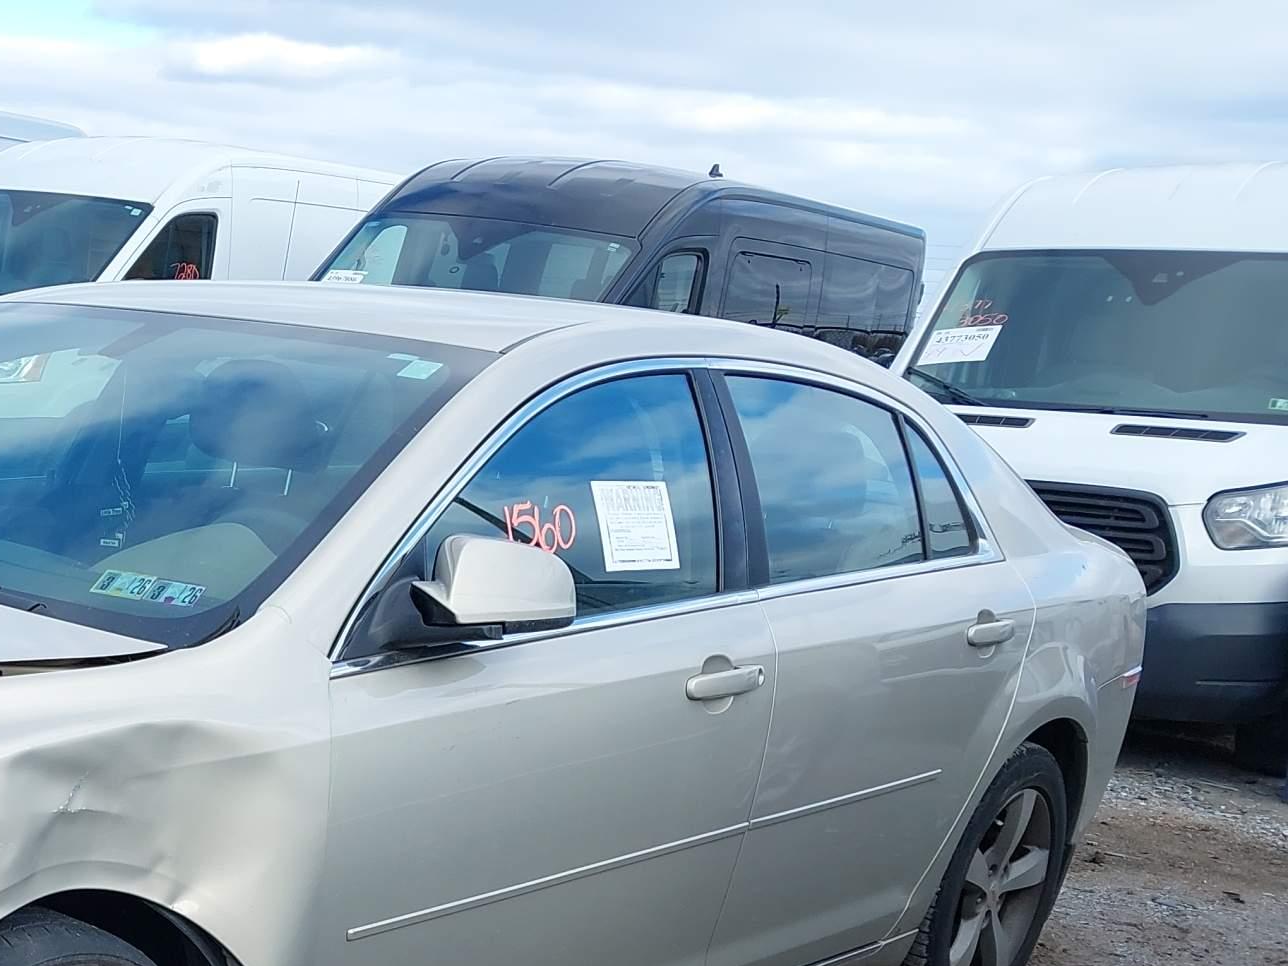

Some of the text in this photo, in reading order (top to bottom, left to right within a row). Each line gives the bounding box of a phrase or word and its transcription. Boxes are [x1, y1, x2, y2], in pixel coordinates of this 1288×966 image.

[504, 500, 576, 553] 1560
[100, 576, 115, 591] 3
[150, 585, 166, 600] 3
